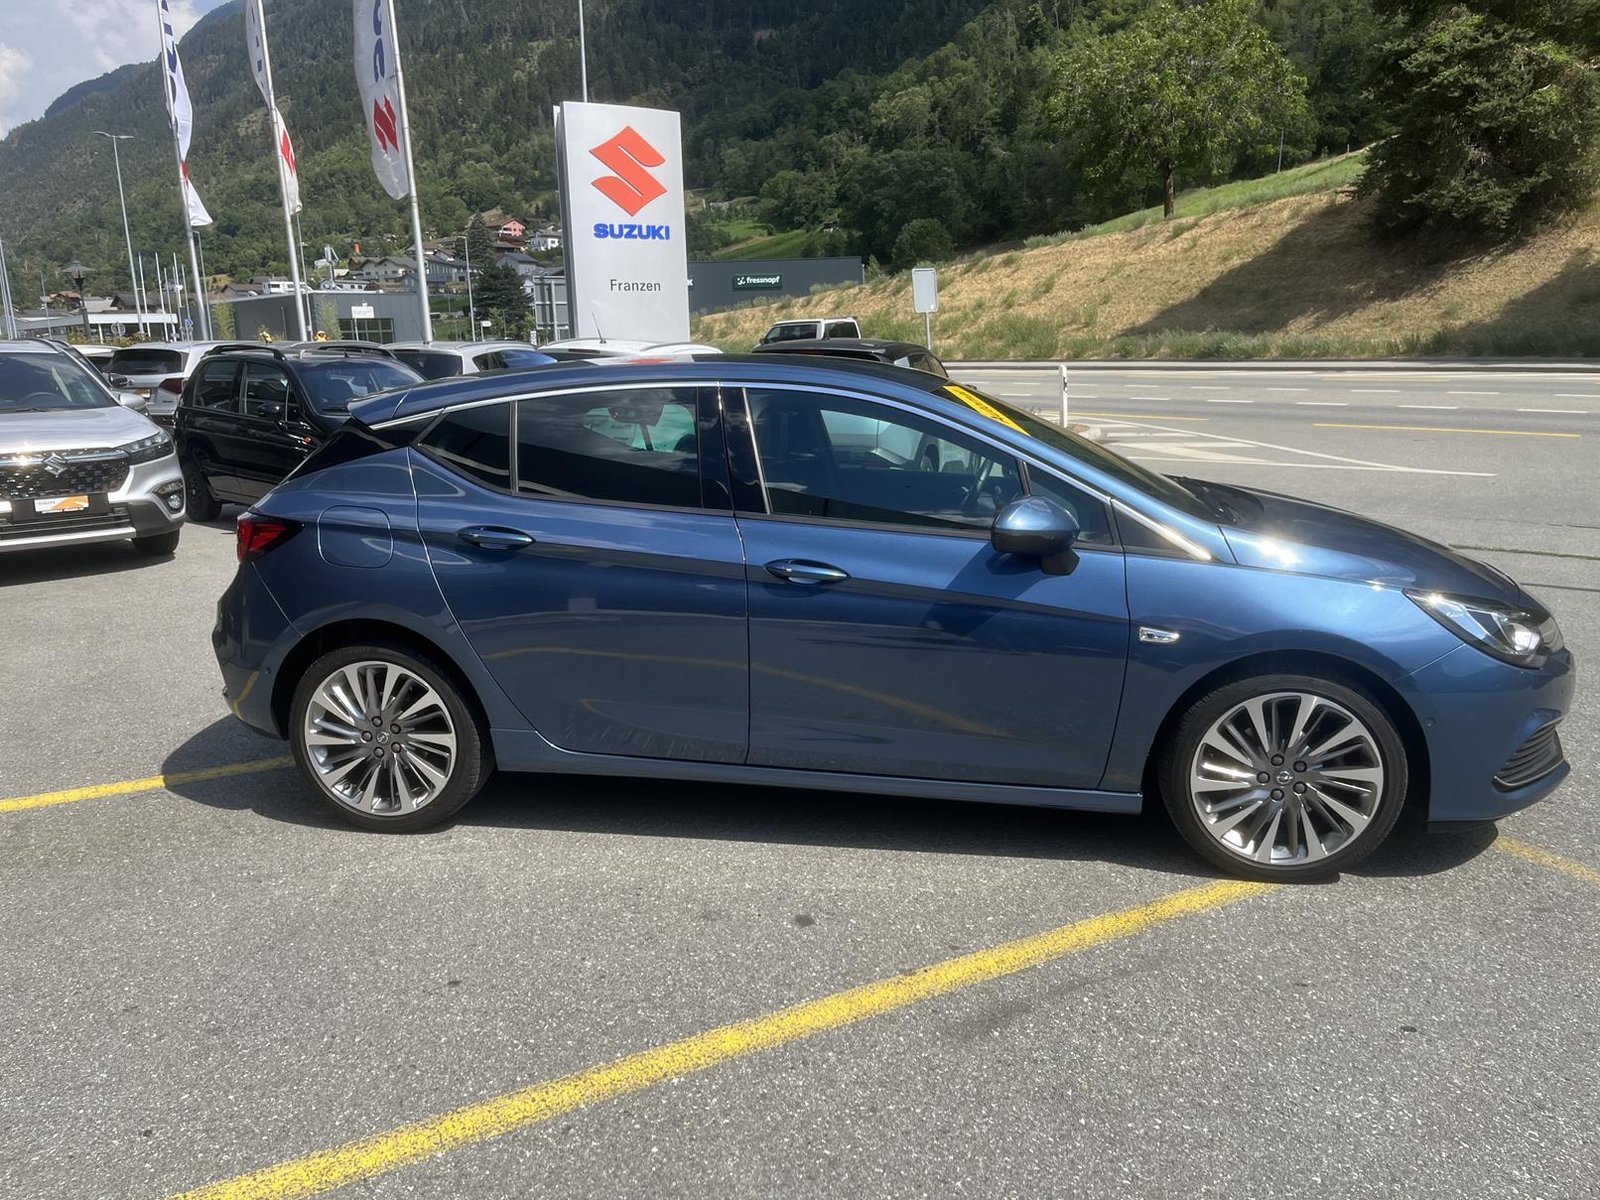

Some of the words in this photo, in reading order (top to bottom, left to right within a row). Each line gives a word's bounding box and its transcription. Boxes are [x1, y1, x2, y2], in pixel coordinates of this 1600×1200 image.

[593, 223, 671, 240] SUZUKI
[610, 279, 662, 292] Franzen
[746, 275, 780, 285] fressnapf
